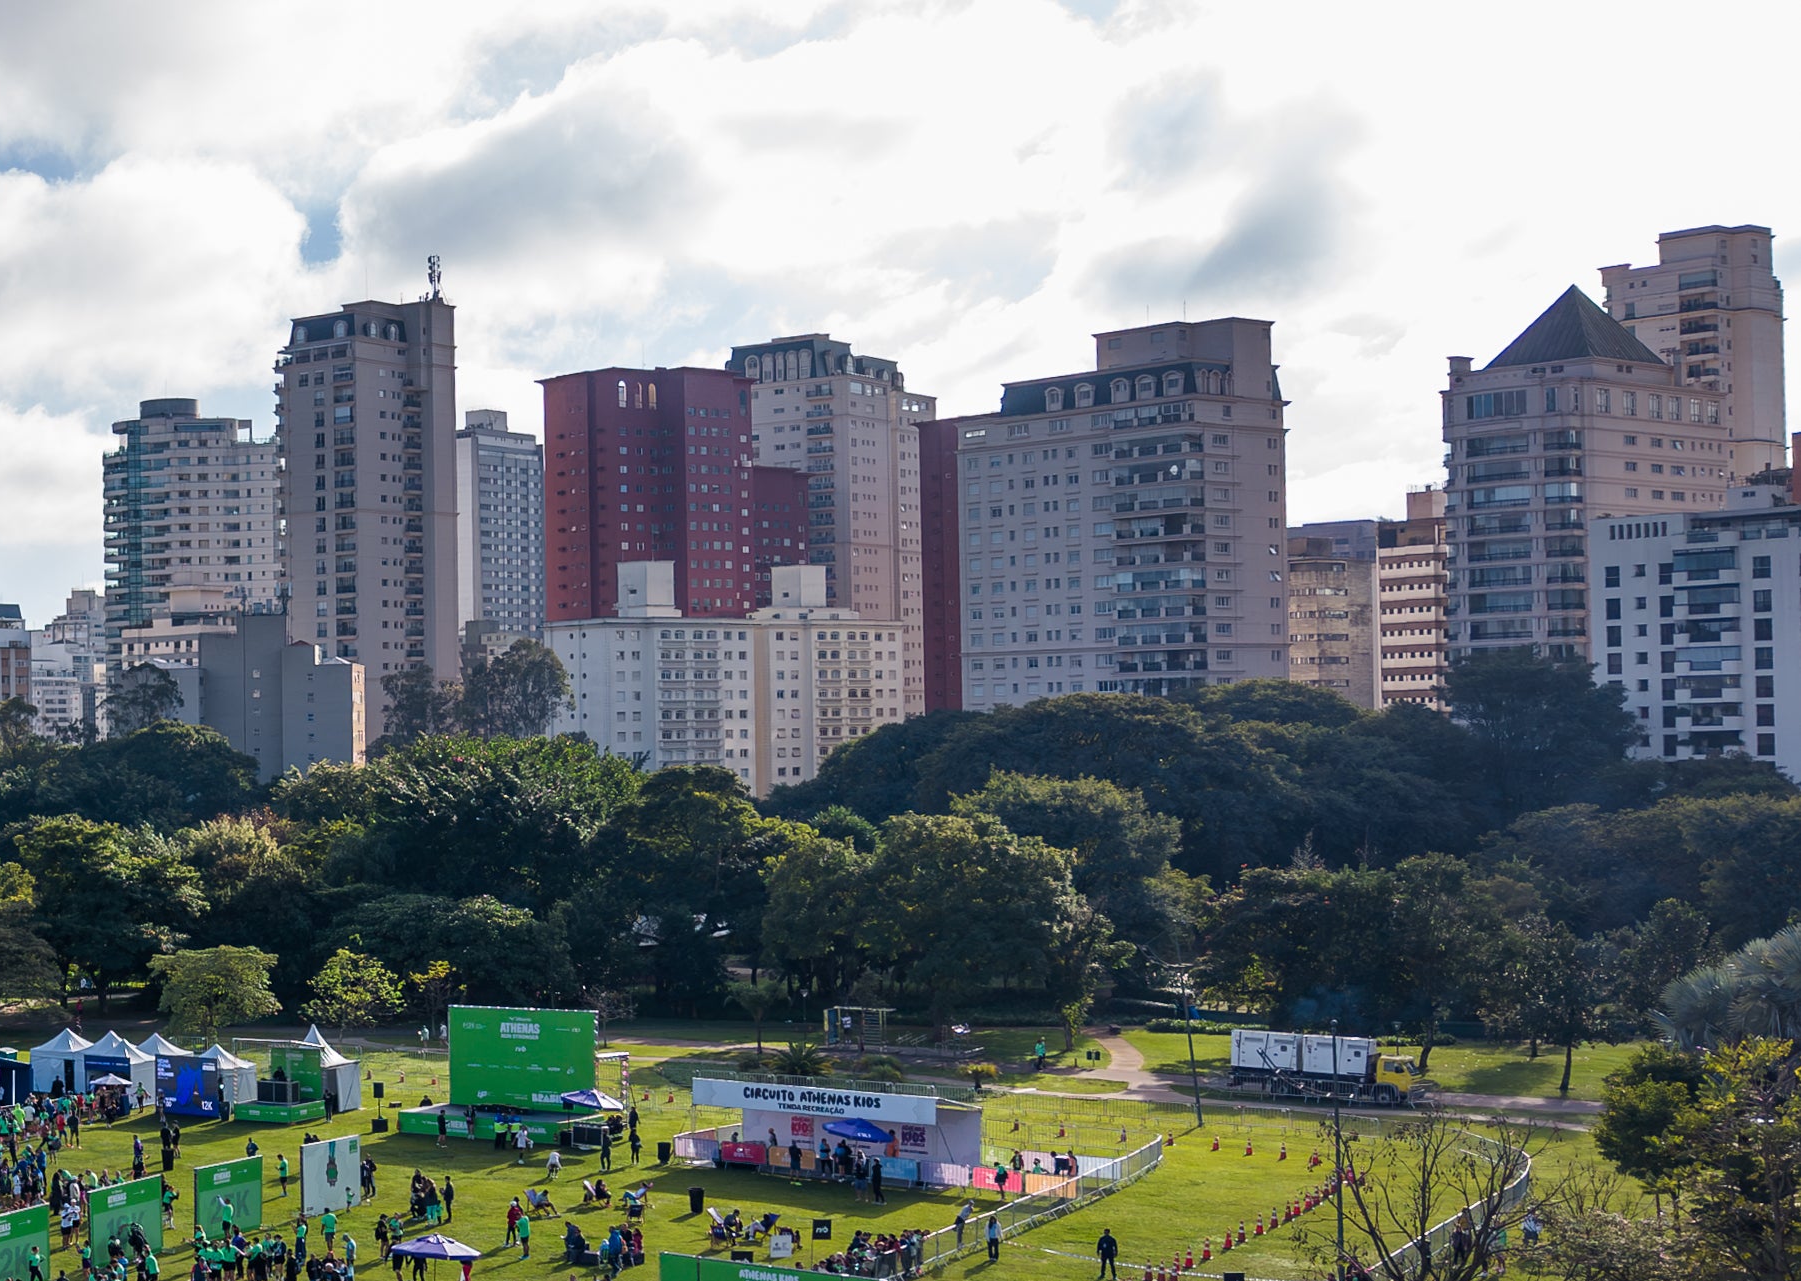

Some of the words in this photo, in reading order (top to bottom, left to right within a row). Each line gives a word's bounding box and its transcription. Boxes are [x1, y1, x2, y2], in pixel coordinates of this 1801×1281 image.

[500, 1022, 540, 1035] ATHENAS
[743, 1086, 796, 1102] CIRCUITO
[799, 1091, 851, 1107] ATHENAS
[853, 1095, 881, 1109] KIDS
[778, 1102, 801, 1111] TENDA
[802, 1104, 845, 1115] RECREAÇÃO
[209, 1188, 250, 1225] 2K
[814, 1225, 829, 1235] rvb
